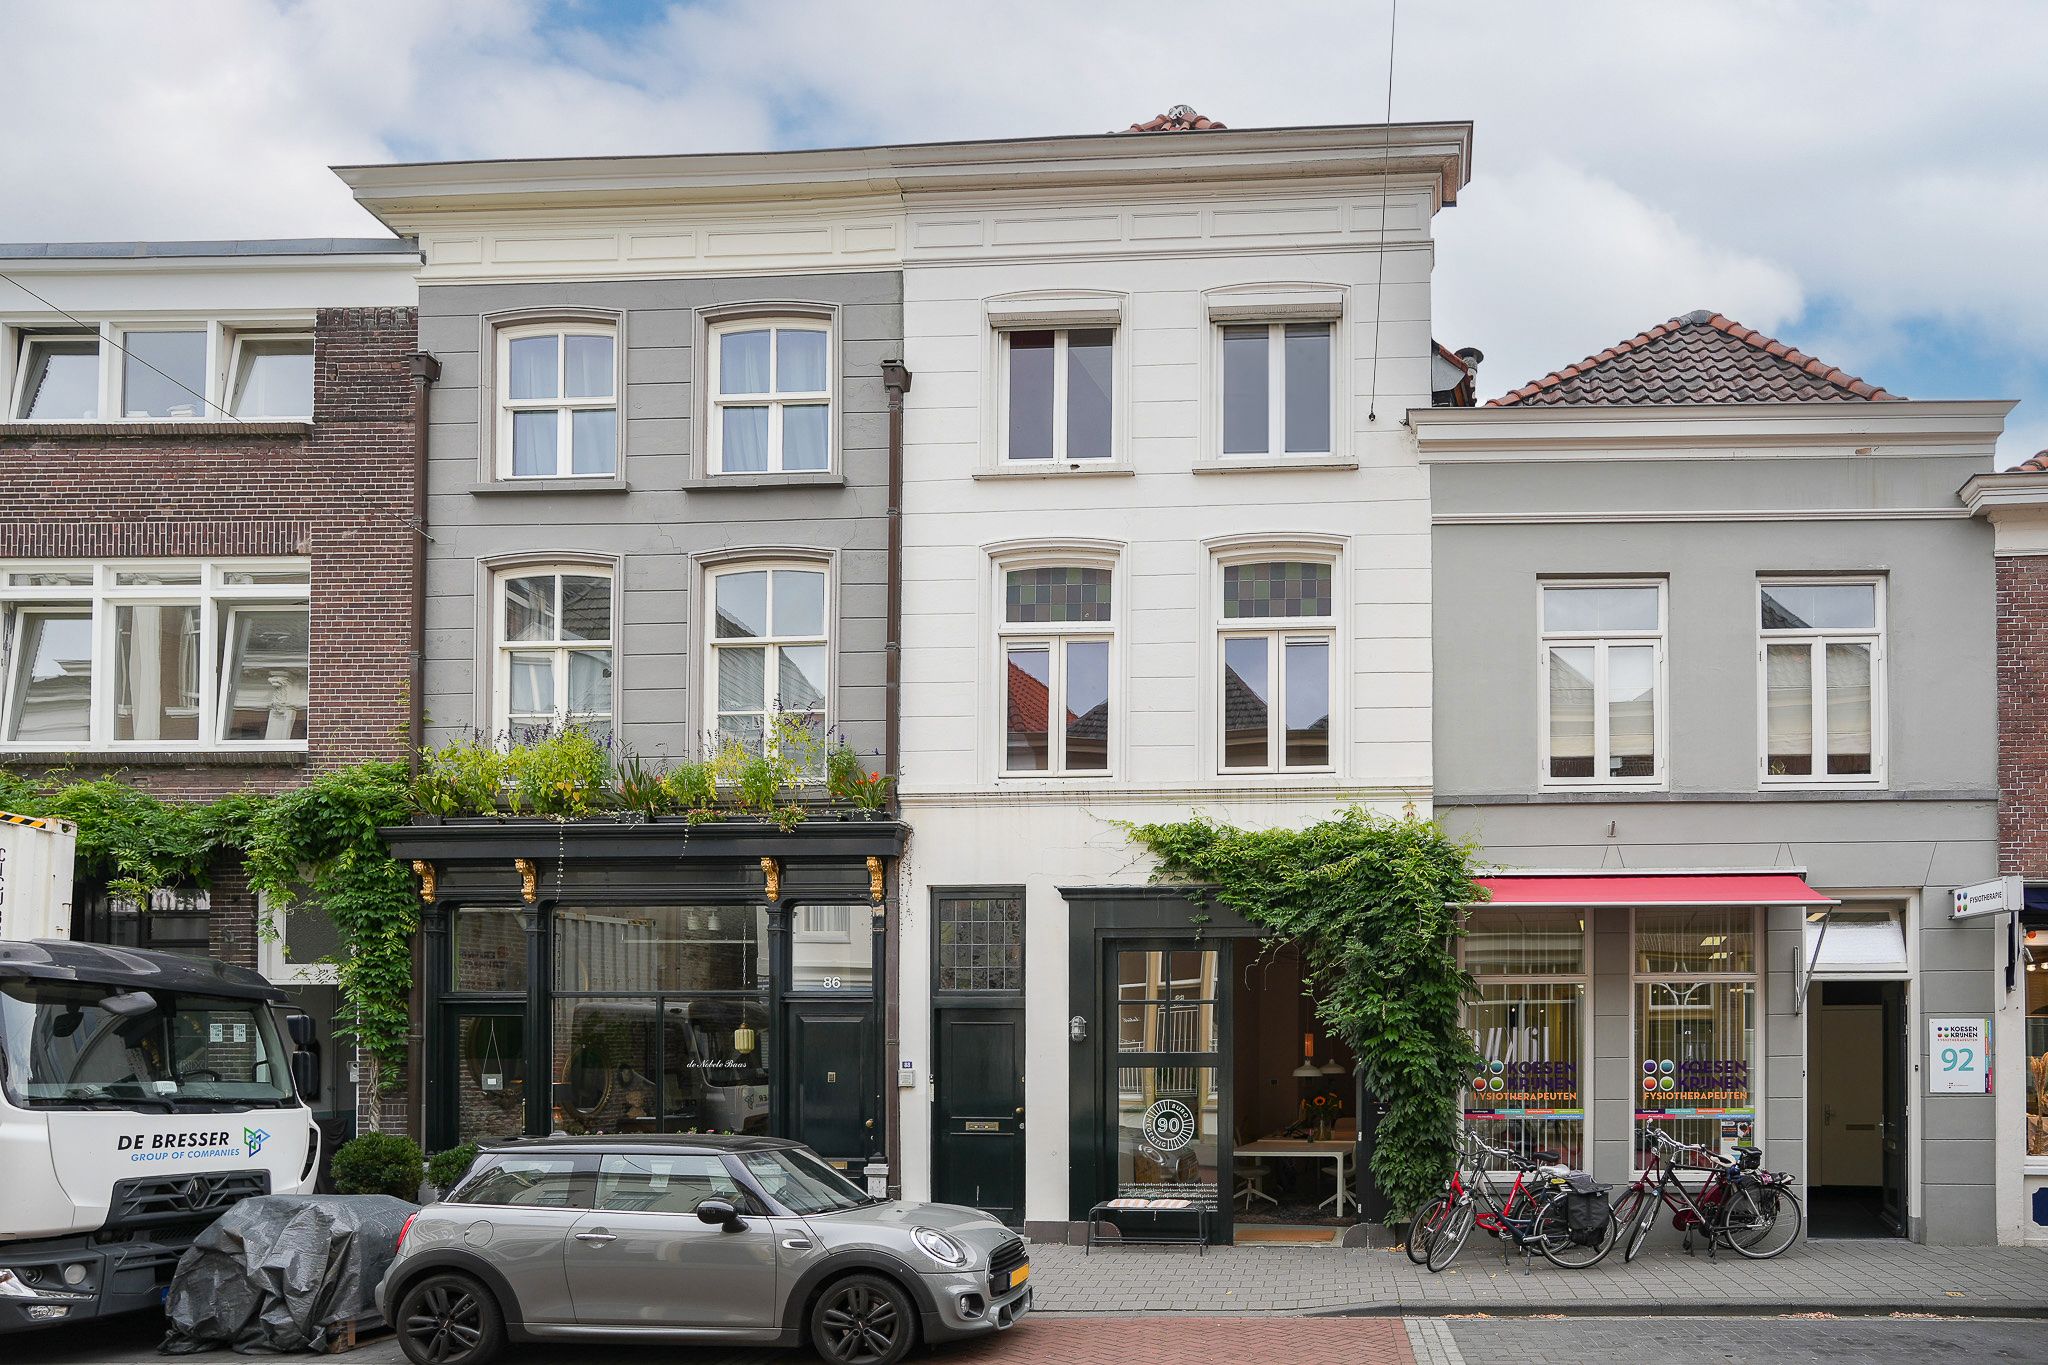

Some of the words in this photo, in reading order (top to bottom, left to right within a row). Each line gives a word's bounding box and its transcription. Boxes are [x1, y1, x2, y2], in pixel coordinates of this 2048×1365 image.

[1969, 891, 2002, 904] FYSIOTHERAPIE
[823, 976, 842, 989] 86
[686, 1059, 697, 1068] de
[724, 1059, 747, 1068] Baas
[1677, 1060, 1748, 1074] KOESEN
[1941, 1048, 1975, 1072] 92
[1507, 1061, 1577, 1075] KOESEN
[1643, 1091, 1748, 1100] FYSIOTHERAPEUTEN
[1171, 1103, 1189, 1119] BURO
[1157, 1117, 1180, 1133] 90
[117, 1135, 145, 1151] DE
[152, 1131, 230, 1149] BRESSER
[131, 1151, 168, 1162] GROUP
[171, 1151, 185, 1160] OF
[187, 1148, 240, 1159] COMPANIES
